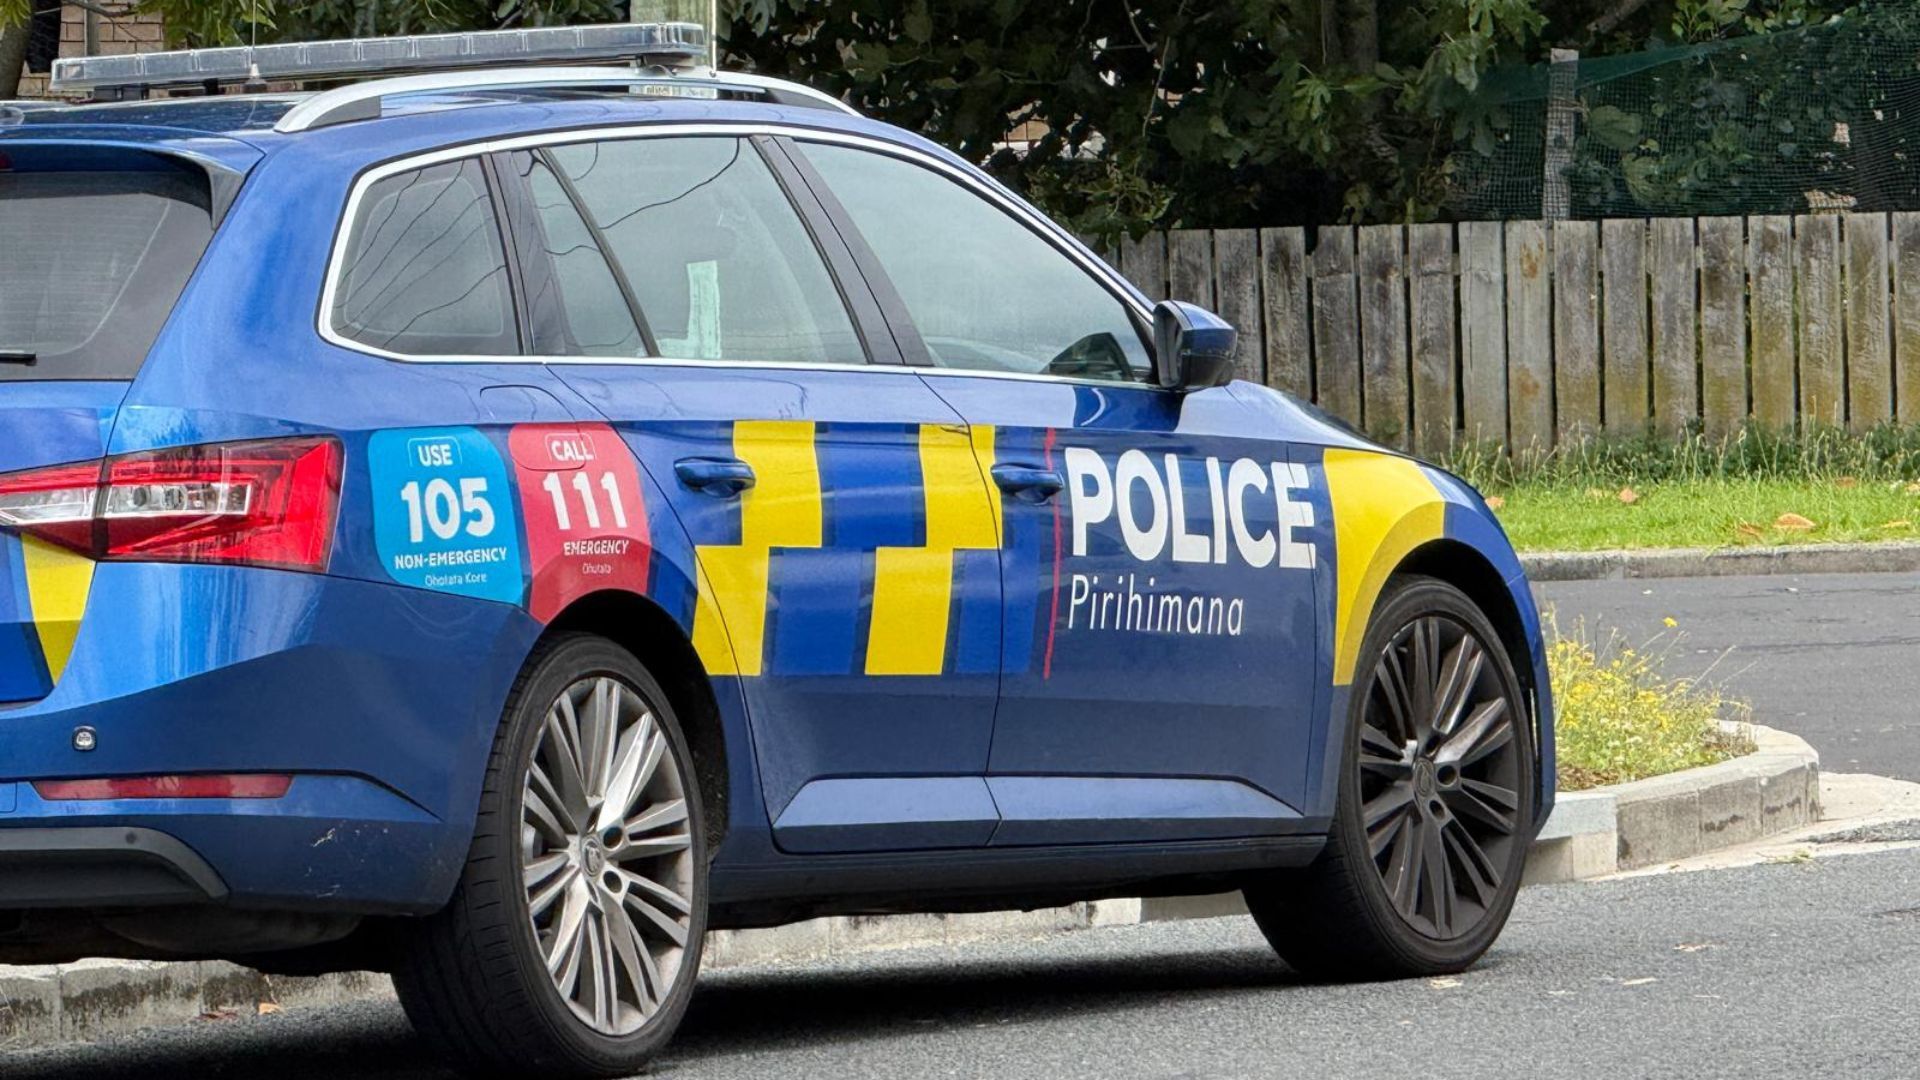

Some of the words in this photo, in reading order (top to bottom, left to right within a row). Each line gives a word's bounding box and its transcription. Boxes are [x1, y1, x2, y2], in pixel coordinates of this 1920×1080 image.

[418, 445, 453, 467] USE
[551, 441, 594, 461] CALL
[401, 477, 495, 543] 105
[543, 471, 628, 530] 111
[1065, 447, 1316, 569] POLICE
[395, 547, 507, 569] NON-EMERGENCY
[563, 540, 629, 556] EMERGENCY
[464, 572, 487, 584] Kore
[1068, 573, 1243, 636] Pirihimana
